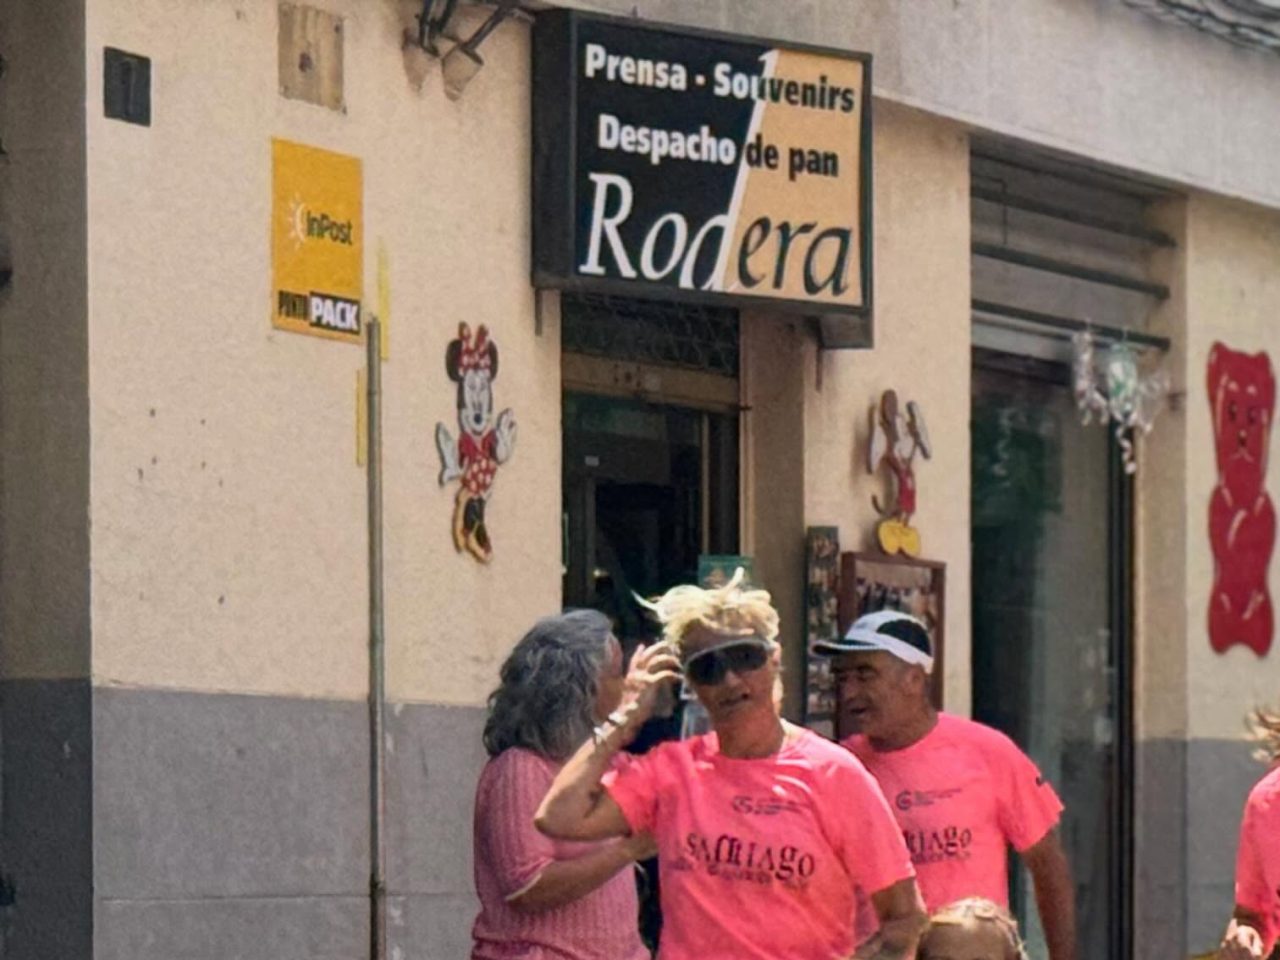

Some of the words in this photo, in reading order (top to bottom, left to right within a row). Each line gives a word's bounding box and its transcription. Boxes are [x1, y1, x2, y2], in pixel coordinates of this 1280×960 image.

[584, 43, 687, 91] Prensa
[713, 62, 855, 114] Souvenirs
[598, 113, 737, 165] Despacho
[745, 133, 778, 171] de
[788, 148, 839, 181] pan
[306, 210, 353, 246] InPost
[578, 165, 853, 297] Rodera
[310, 296, 360, 332] PACK
